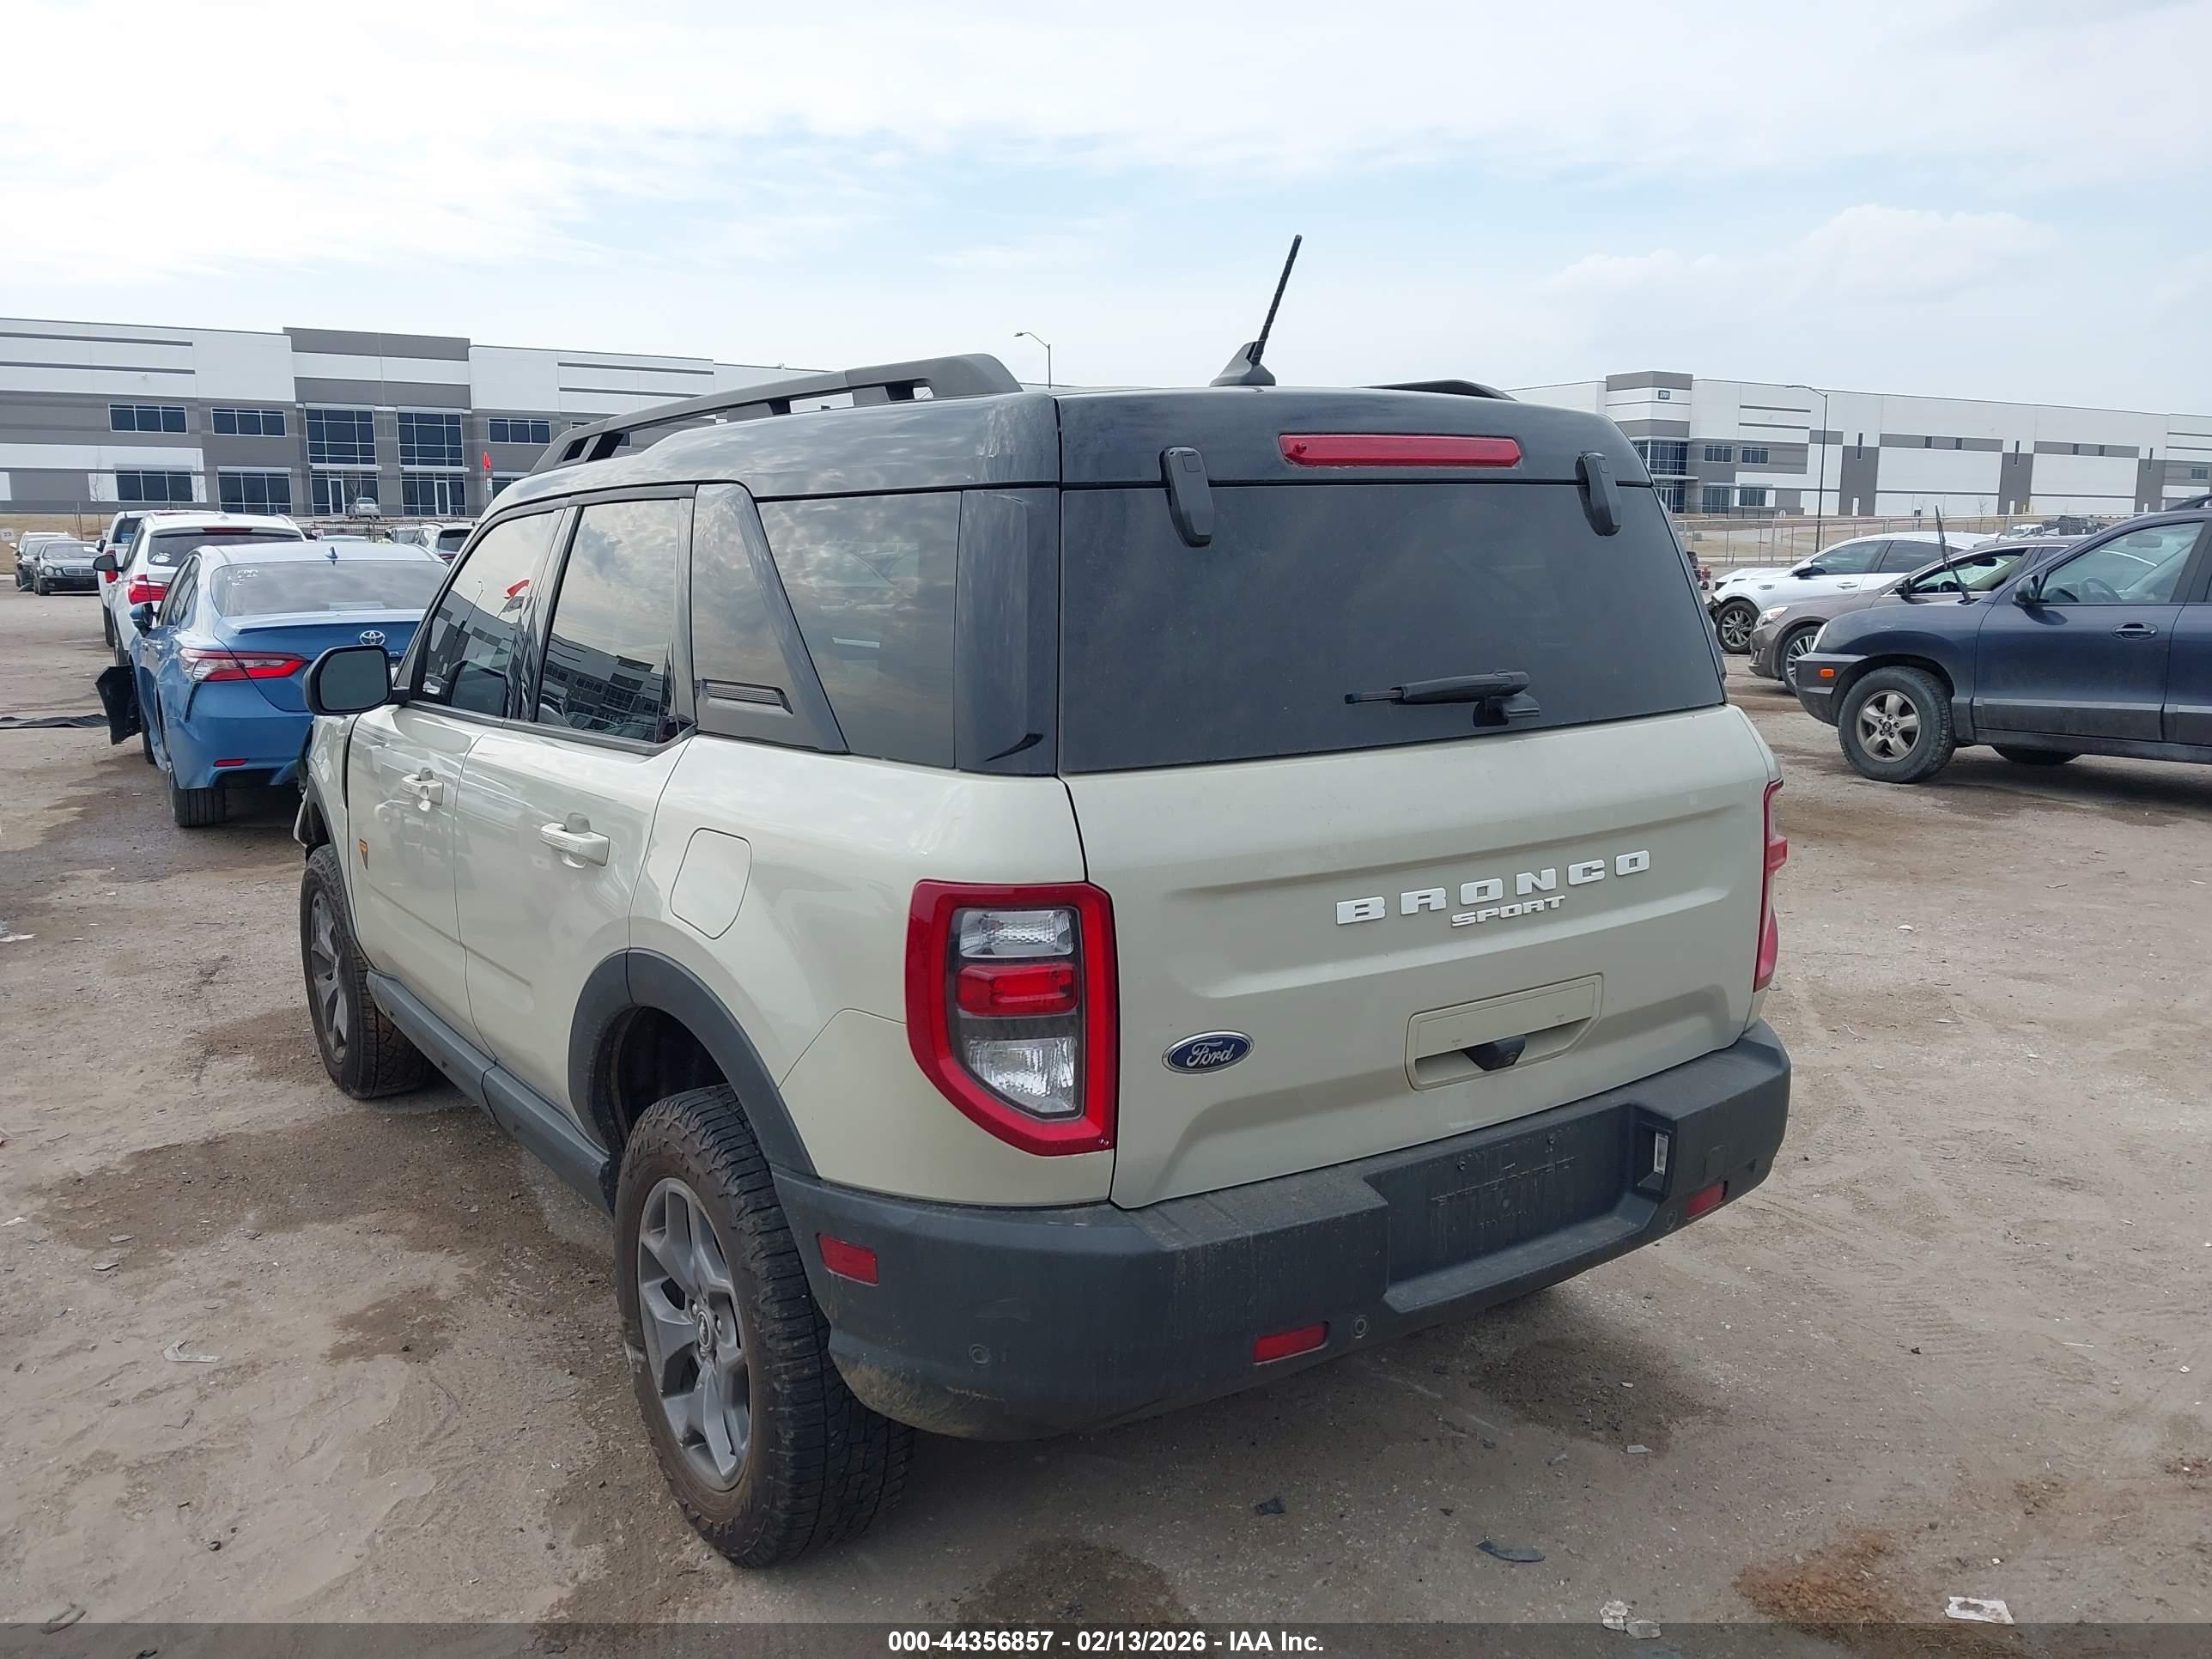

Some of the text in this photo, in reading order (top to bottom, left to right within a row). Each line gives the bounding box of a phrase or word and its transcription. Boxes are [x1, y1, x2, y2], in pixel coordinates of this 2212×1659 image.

[1336, 849, 1650, 925] BRONCO
[1450, 895, 1566, 927] SPORT
[1186, 1040, 1236, 1066] Ford
